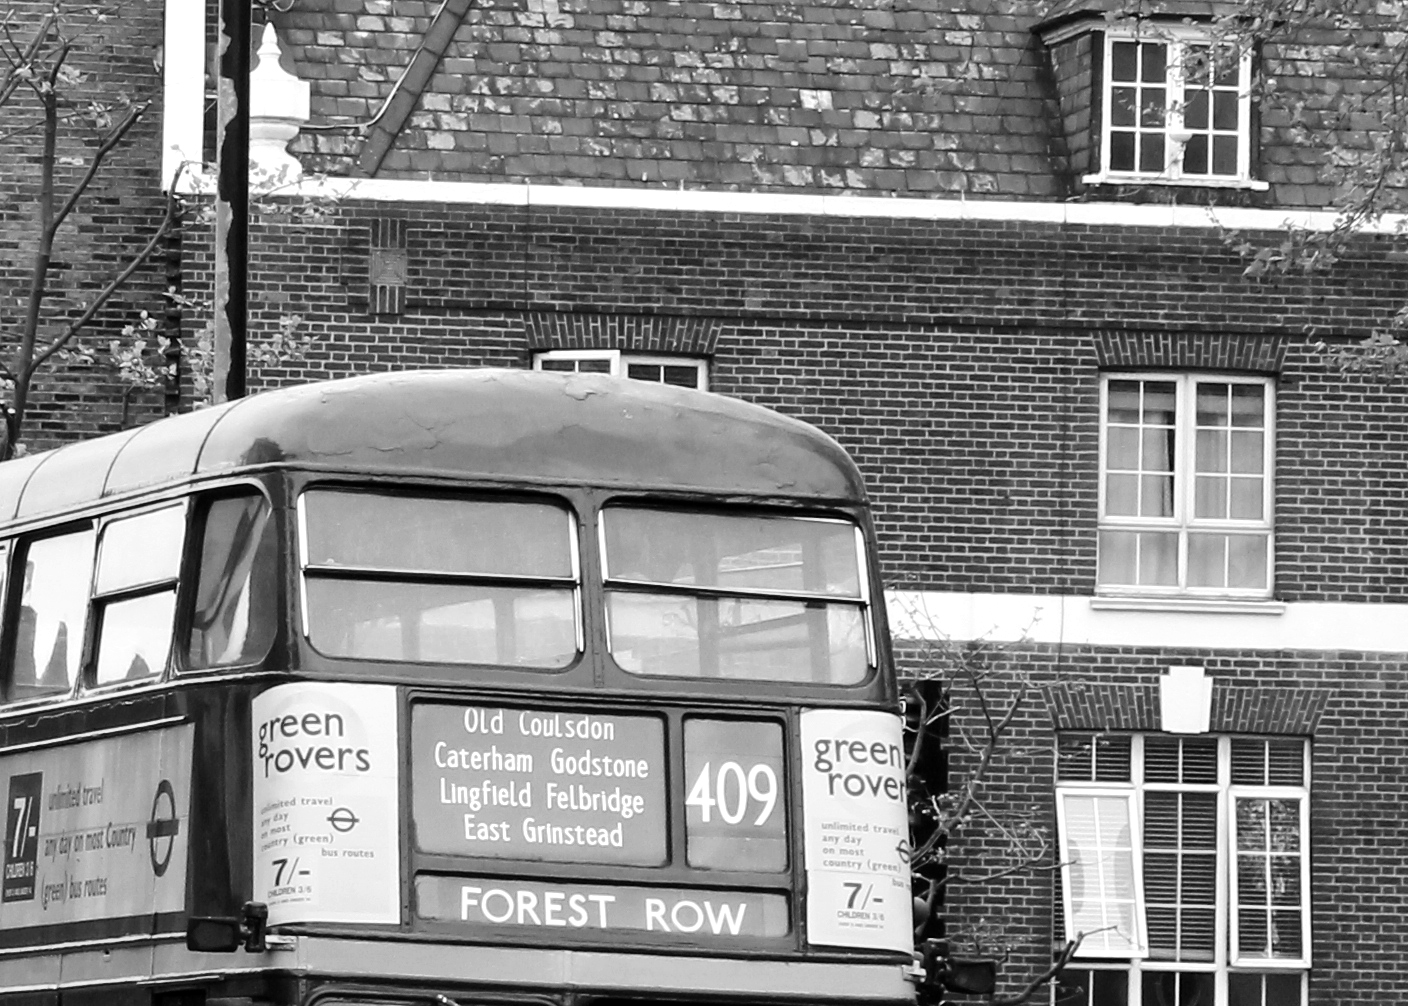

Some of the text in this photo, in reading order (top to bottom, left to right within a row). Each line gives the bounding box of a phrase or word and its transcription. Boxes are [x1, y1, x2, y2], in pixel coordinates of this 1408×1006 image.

[259, 713, 344, 759] green
[464, 708, 615, 741] Old Coulsdon
[265, 747, 371, 778] rovers
[434, 741, 649, 778] Caterham Godstone
[814, 739, 901, 773] green
[83, 778, 104, 806] travel
[301, 797, 333, 806] travel
[440, 777, 645, 819] Lingfield Felbridge
[684, 761, 778, 827] 409
[270, 824, 291, 834] most
[273, 812, 289, 823] day
[464, 814, 624, 848] East Grinstead
[821, 822, 900, 836] unlimited travel
[45, 839, 57, 862] any
[59, 829, 72, 861] day
[106, 822, 136, 854] Country
[293, 833, 334, 845] (green)
[321, 848, 374, 858] bus routes
[822, 834, 862, 846] any day
[822, 847, 864, 857] on most
[272, 857, 310, 887] 7/-
[823, 859, 901, 873] country (green)
[461, 886, 747, 935] FOREST ROW
[843, 882, 883, 911] 7/-
[837, 910, 871, 920] CHILDREN
